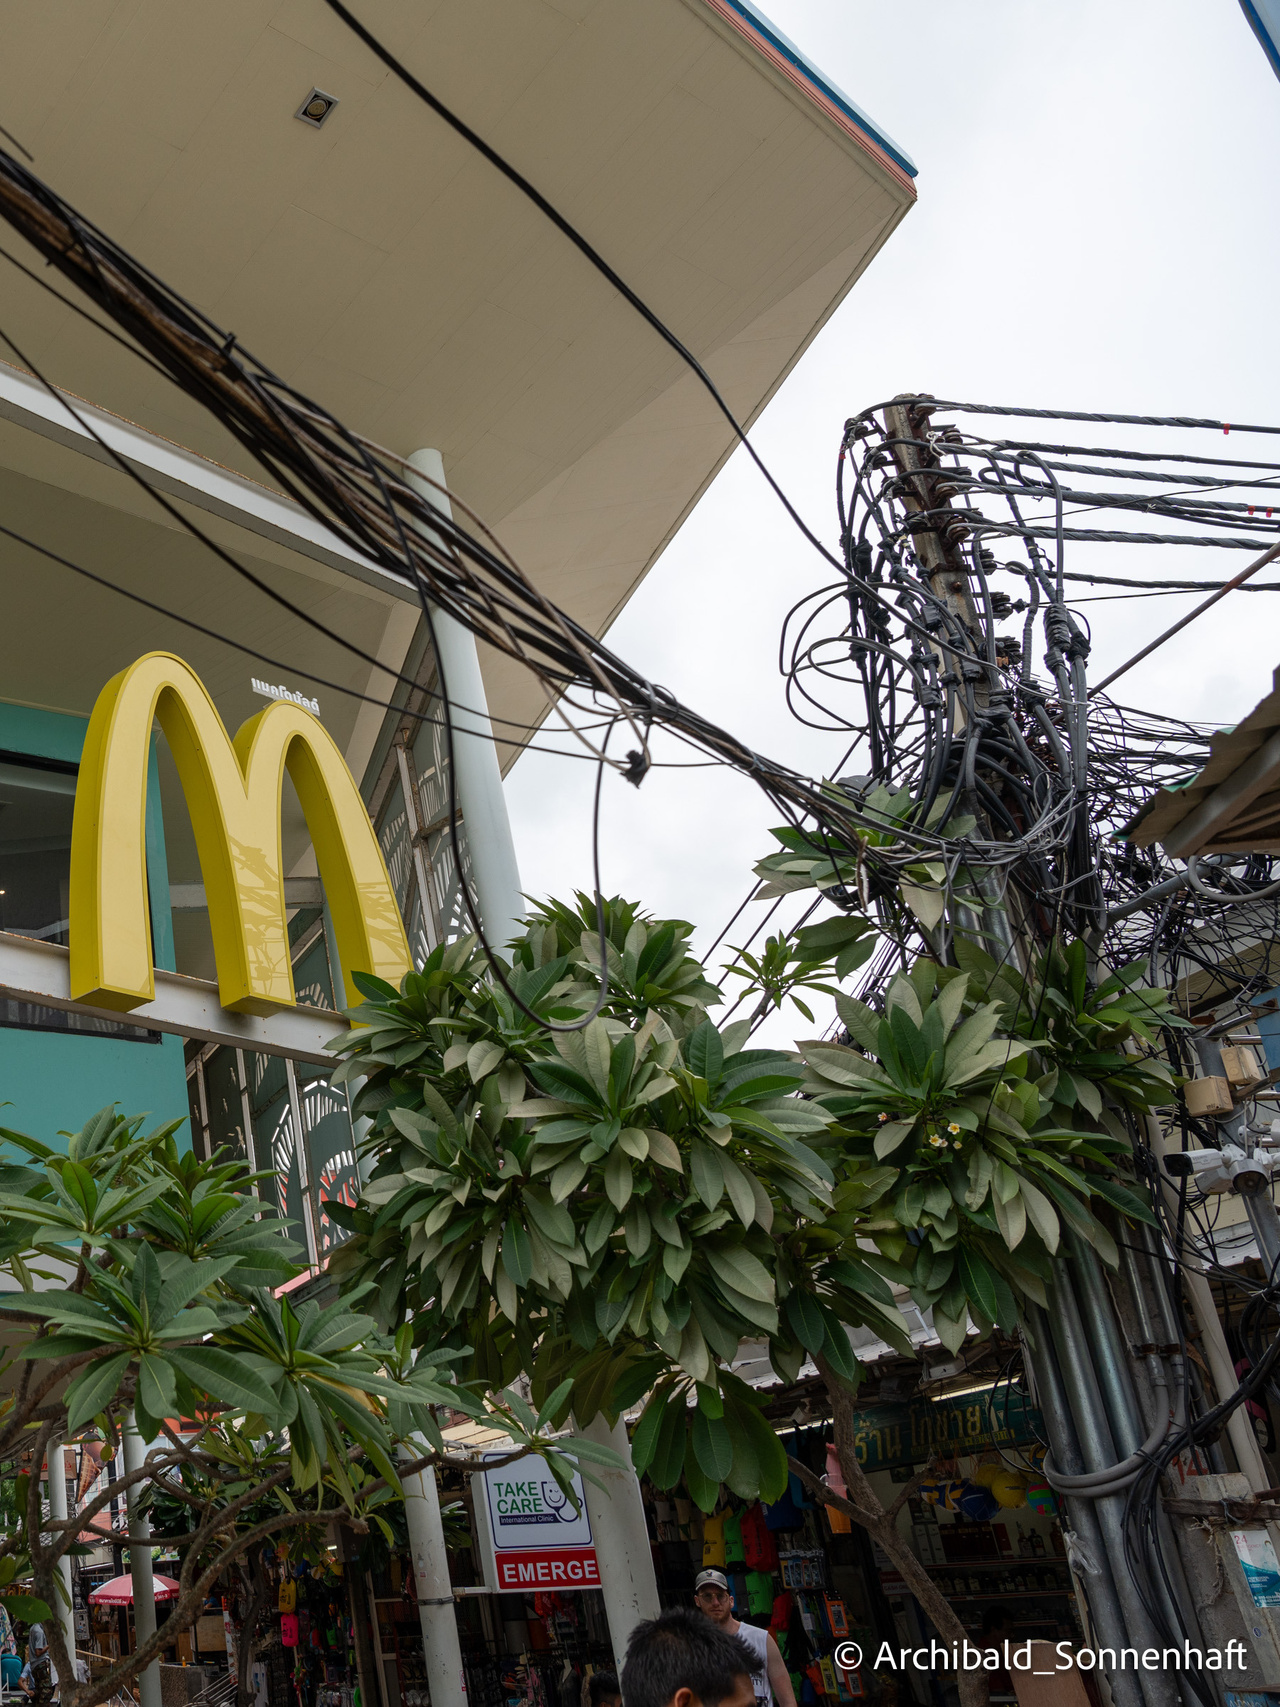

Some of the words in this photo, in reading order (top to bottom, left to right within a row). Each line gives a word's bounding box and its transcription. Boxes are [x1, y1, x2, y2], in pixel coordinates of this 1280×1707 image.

[251, 677, 320, 713] แมคโดนัลด์
[855, 1417, 902, 1465] ร้าน
[494, 1481, 539, 1498] TAKE
[497, 1498, 544, 1515] CARE
[500, 1515, 537, 1524] International
[537, 1515, 554, 1523] Clinic
[503, 1559, 598, 1583] EMERGE
